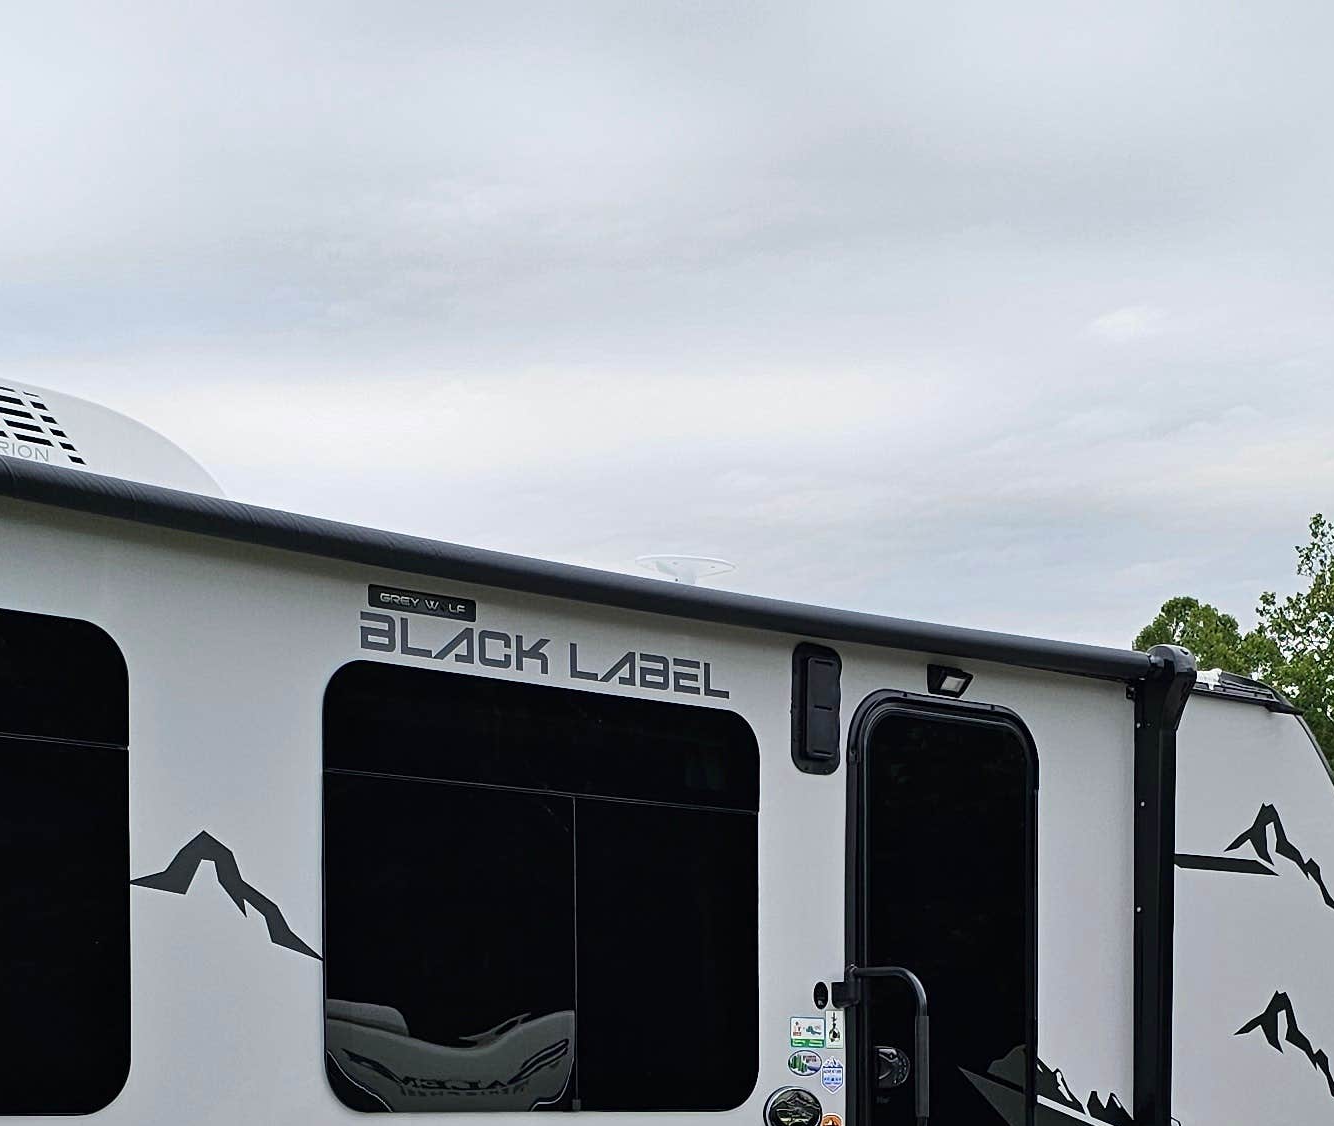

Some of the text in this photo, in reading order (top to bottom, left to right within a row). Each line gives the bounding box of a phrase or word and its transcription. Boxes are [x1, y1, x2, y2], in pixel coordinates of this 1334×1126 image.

[380, 592, 466, 613] GREY WLF
[359, 611, 730, 699] BLACK LABEL
